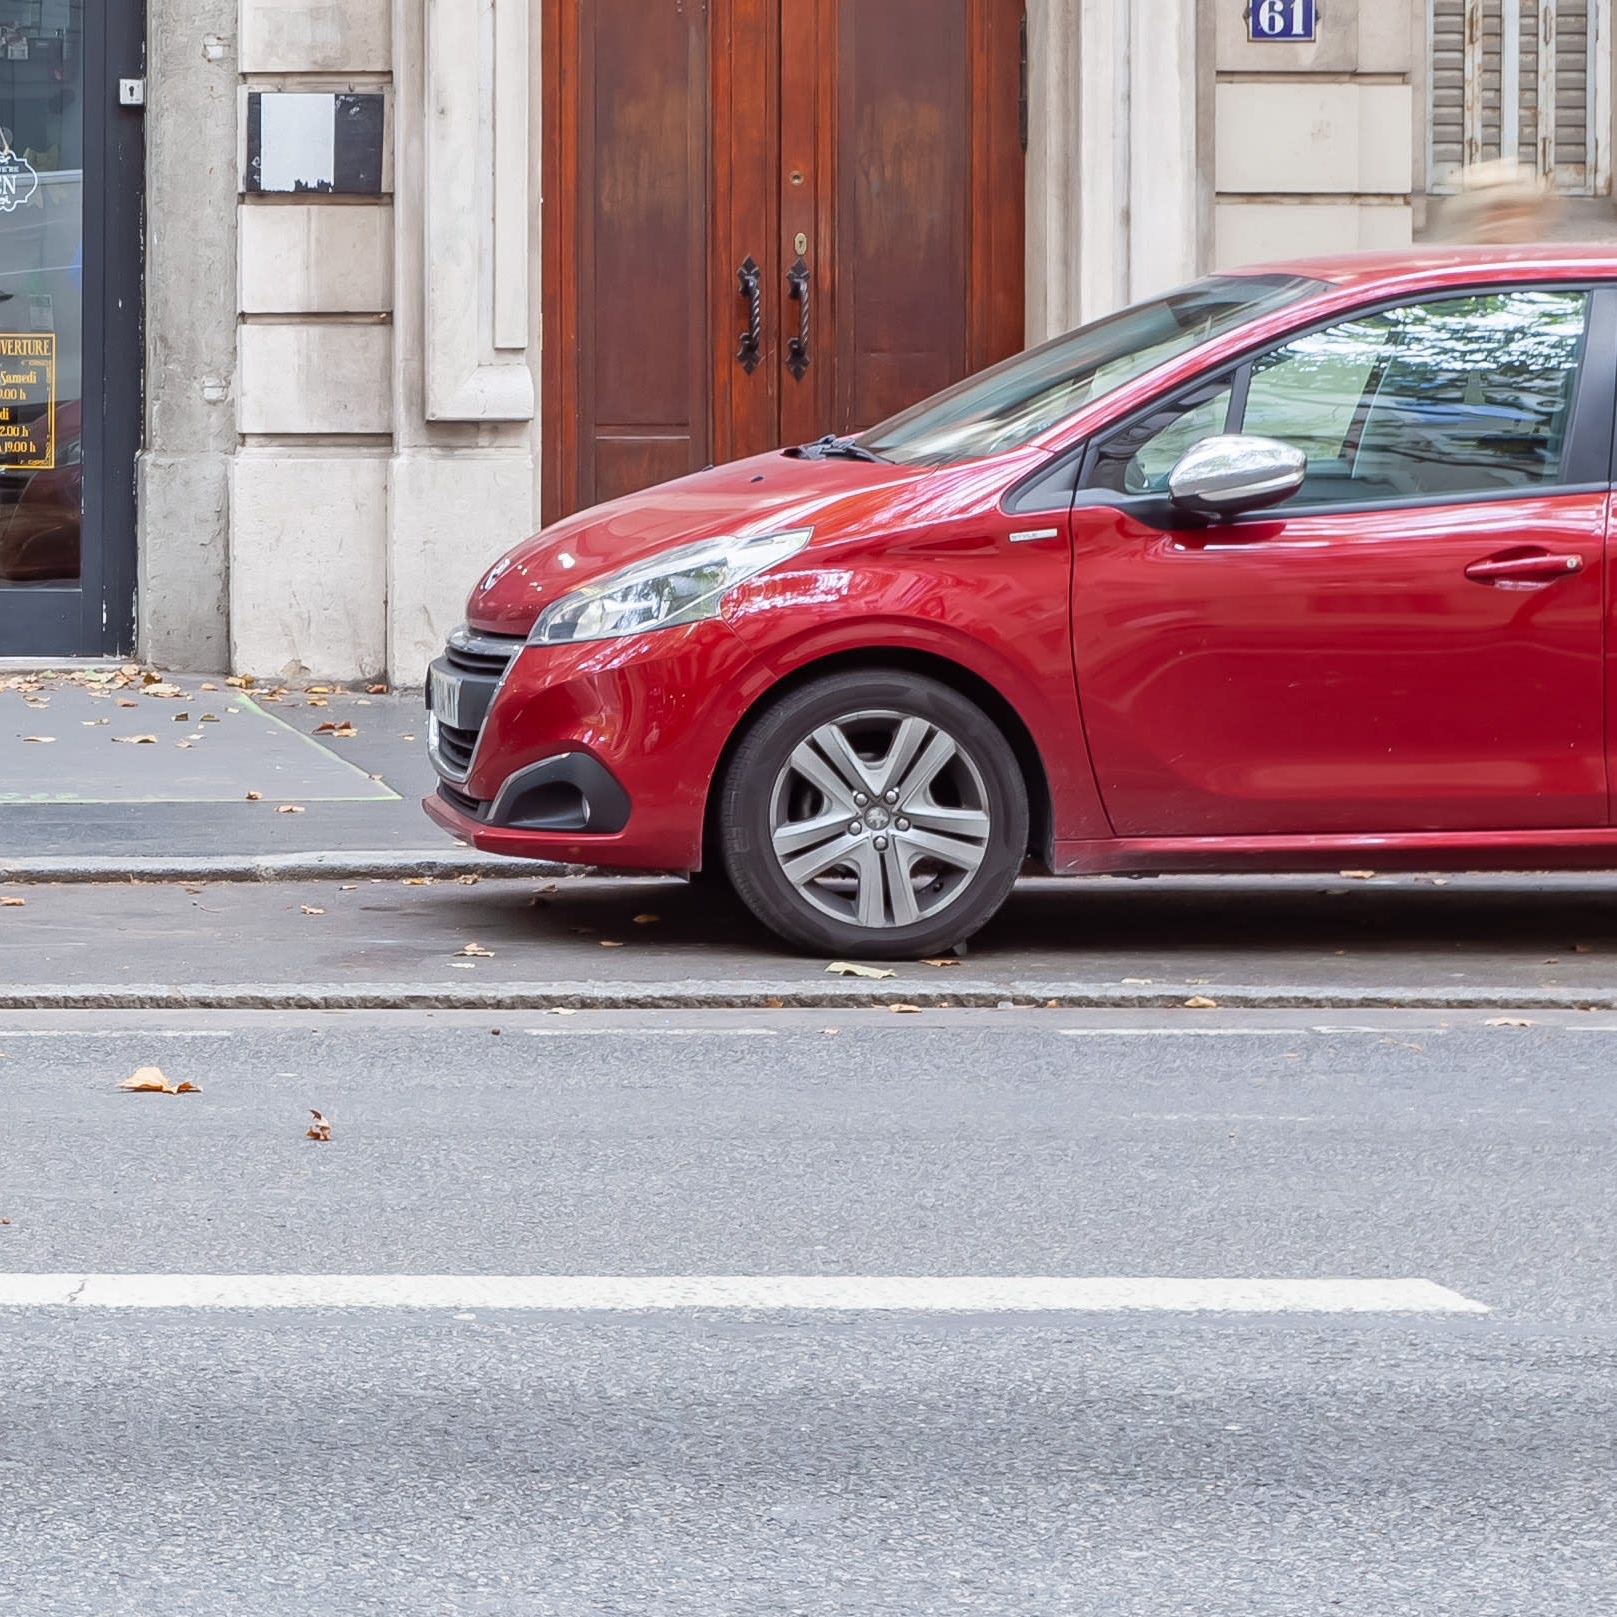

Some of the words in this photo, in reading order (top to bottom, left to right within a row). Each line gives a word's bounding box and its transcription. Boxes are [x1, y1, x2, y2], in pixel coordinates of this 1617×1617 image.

[0, 370, 37, 386] Samedi
[20, 388, 26, 400] h
[29, 441, 36, 453] h
